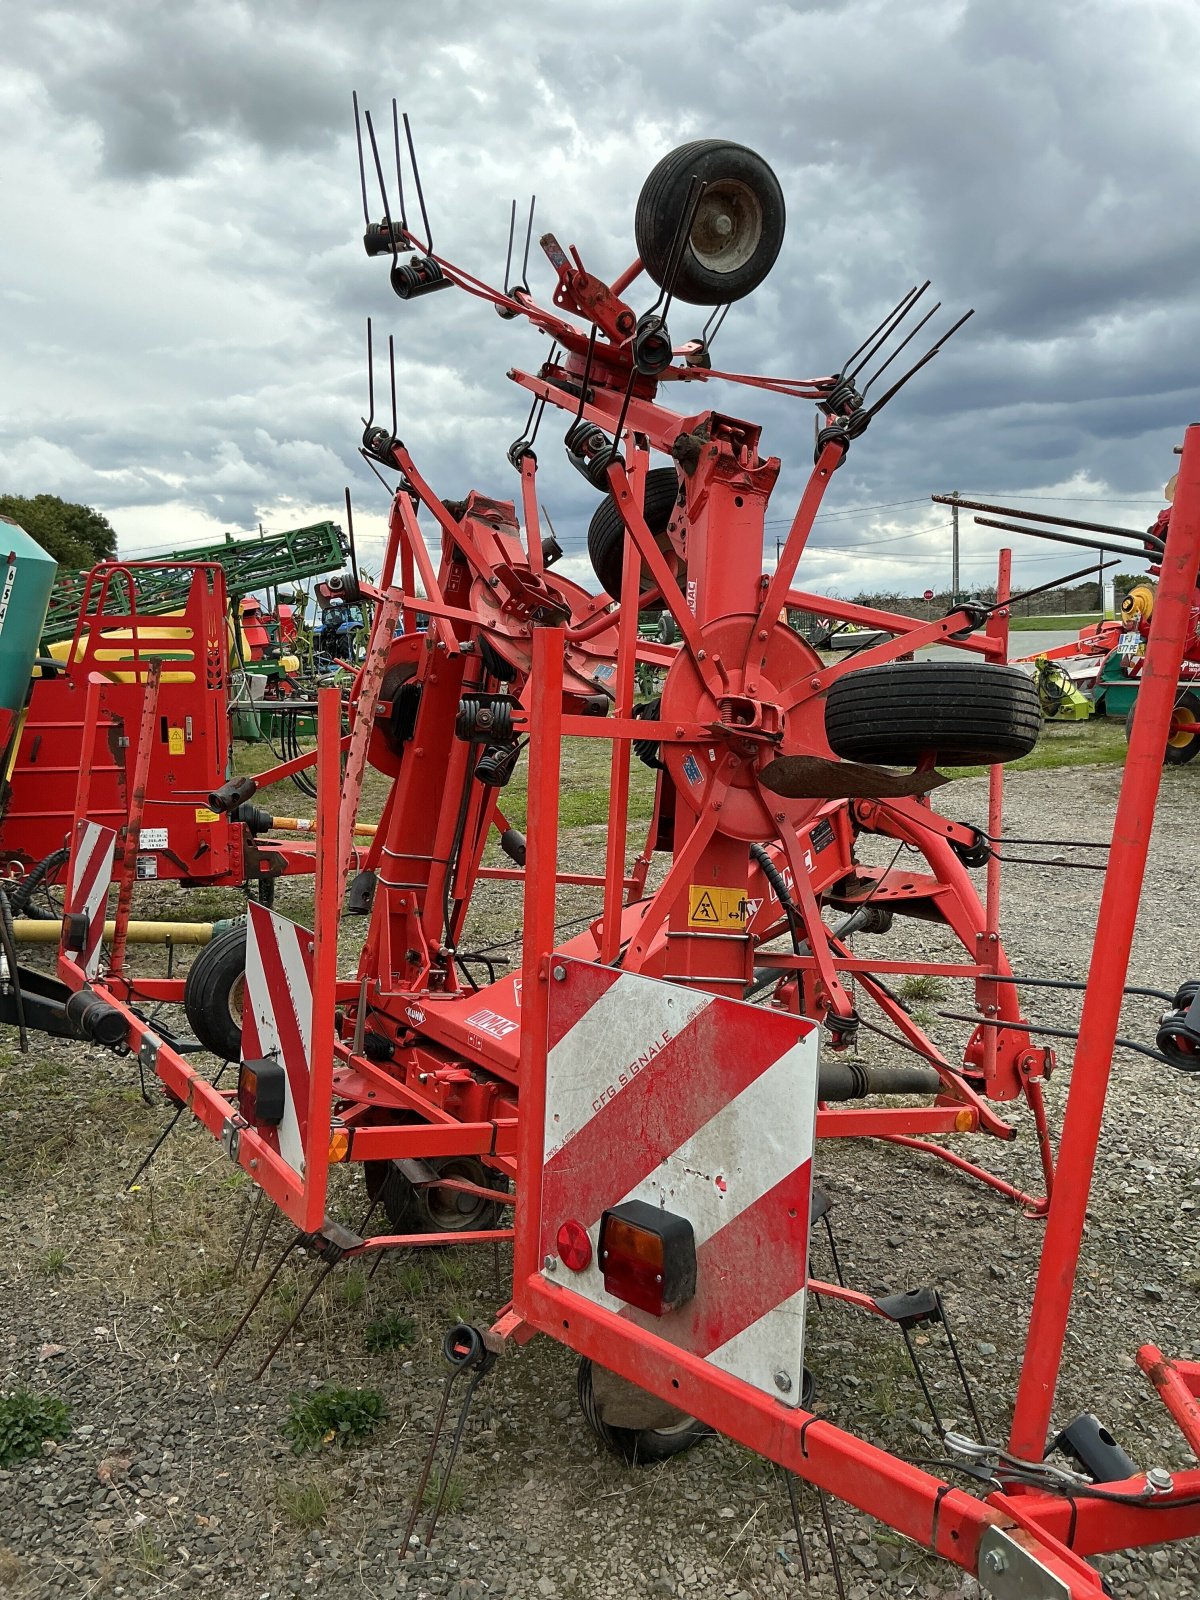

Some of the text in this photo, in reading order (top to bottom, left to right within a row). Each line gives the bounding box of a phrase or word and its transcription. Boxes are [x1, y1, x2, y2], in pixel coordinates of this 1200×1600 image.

[9, 570, 14, 581] 6
[4, 589, 10, 600] 5
[407, 1007, 425, 1022] KUHN
[591, 1085, 617, 1113] CFG
